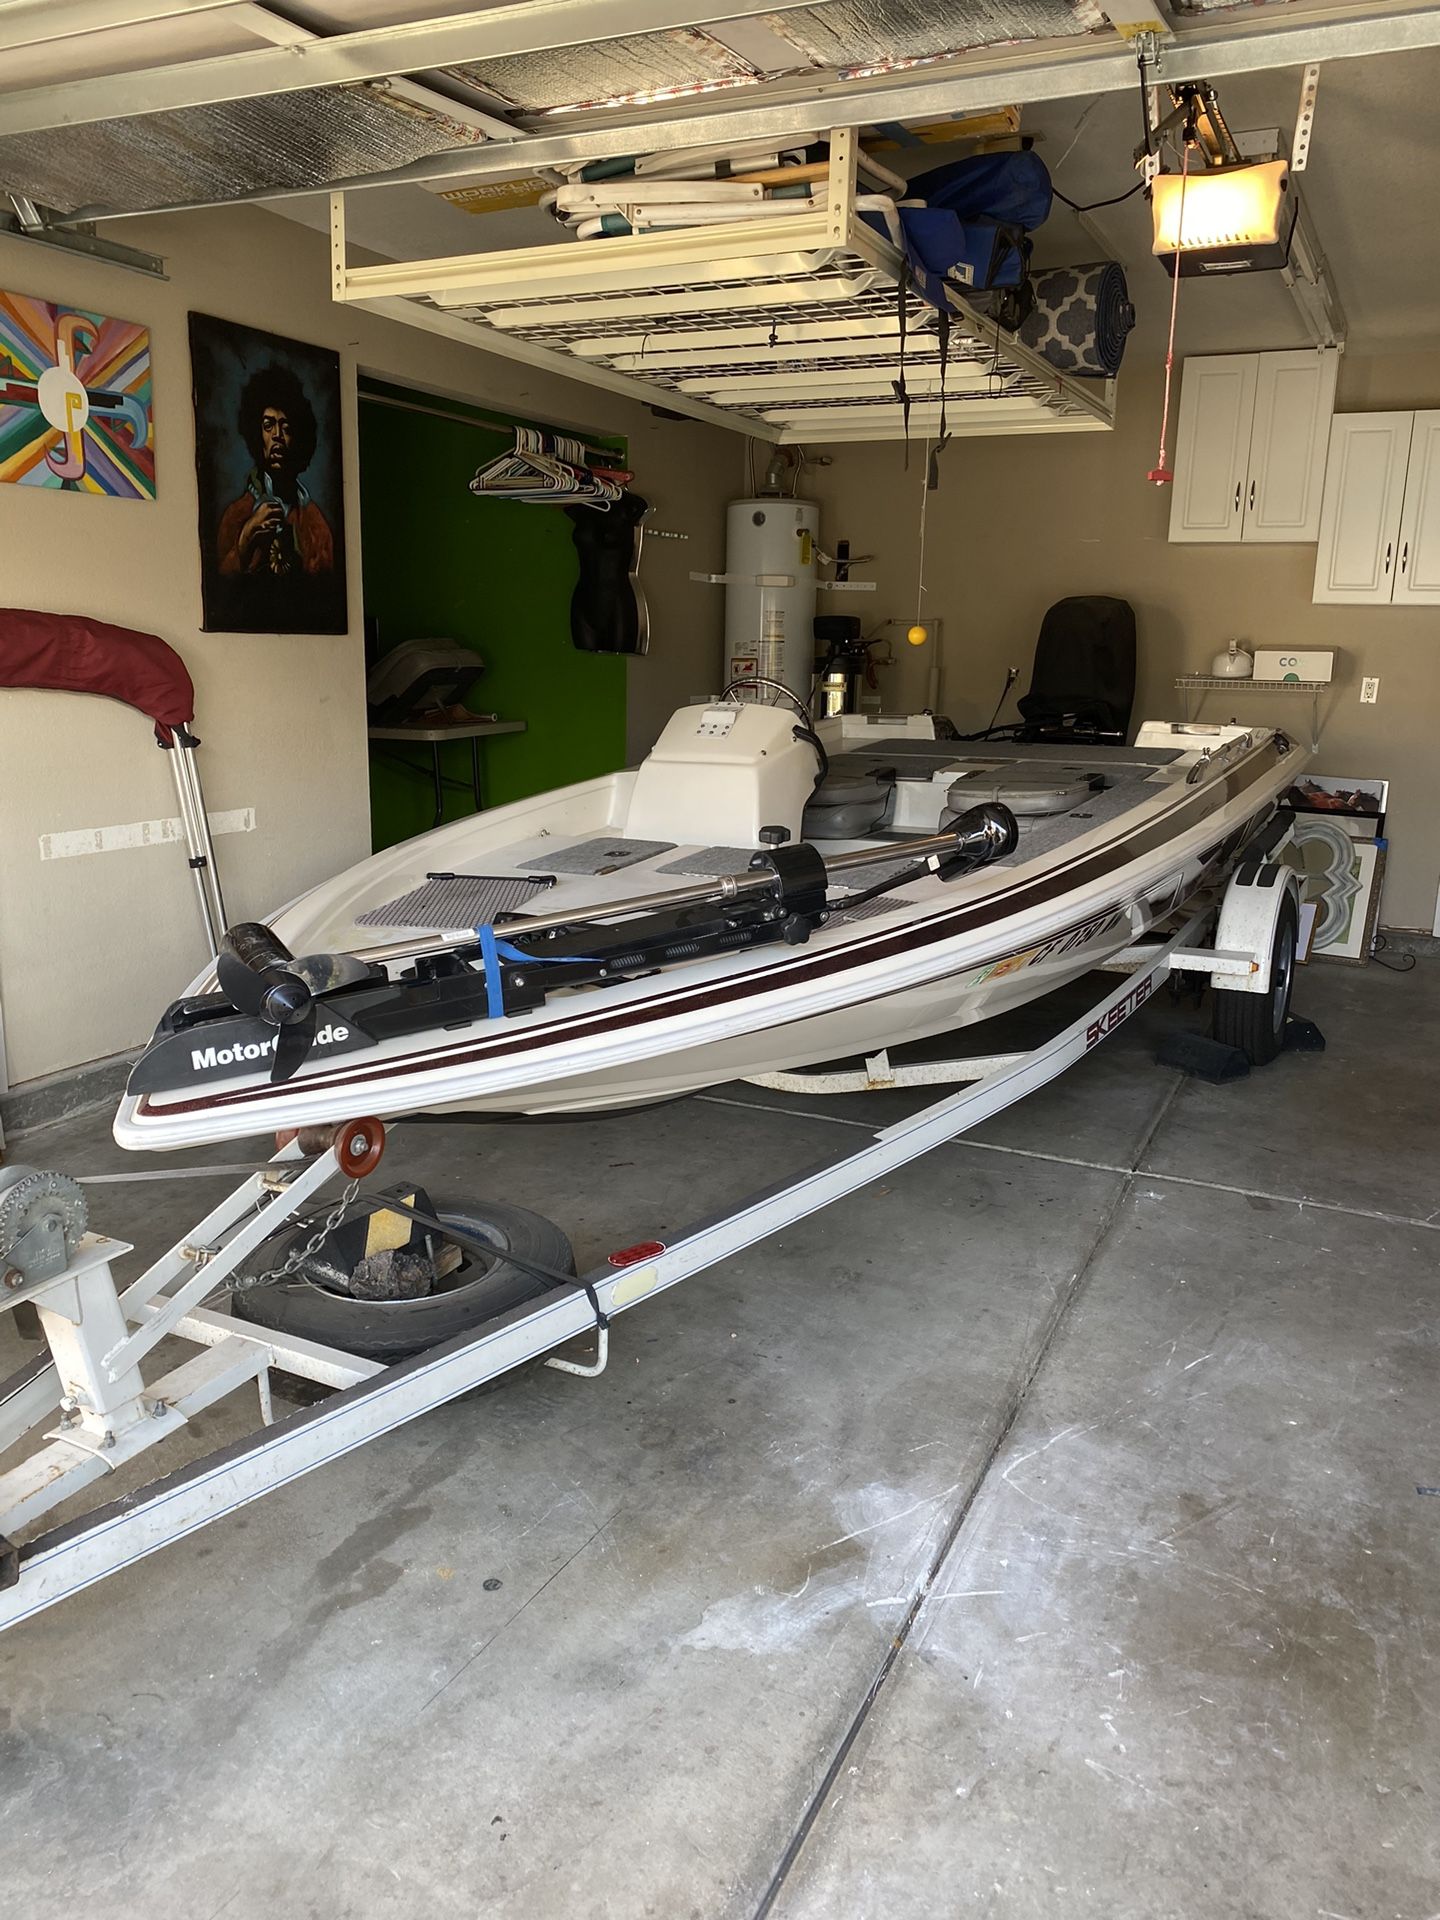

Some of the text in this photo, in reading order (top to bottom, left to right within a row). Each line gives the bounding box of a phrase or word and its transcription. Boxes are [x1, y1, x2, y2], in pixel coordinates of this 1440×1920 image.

[1028, 938, 1064, 966] CF
[1086, 974, 1152, 1050] SKEETER
[191, 1024, 349, 1070] Motorde
